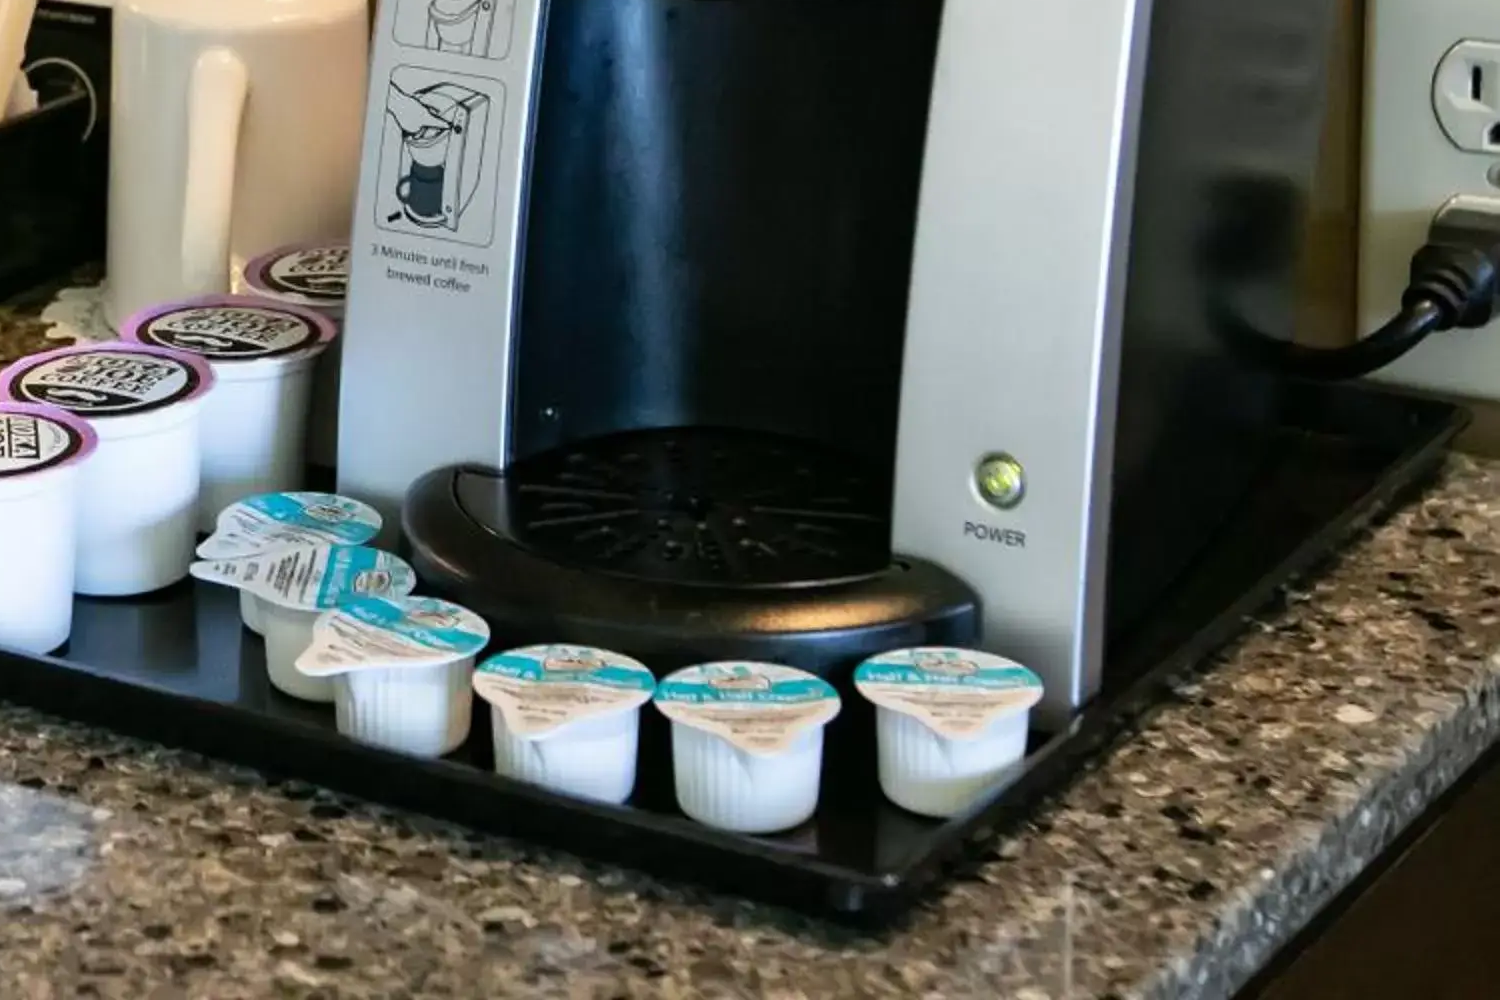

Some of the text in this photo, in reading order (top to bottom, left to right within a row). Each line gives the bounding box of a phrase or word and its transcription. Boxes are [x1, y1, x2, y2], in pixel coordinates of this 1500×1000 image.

[370, 243, 490, 276] 3 Minutes until fresh
[386, 265, 471, 292] brewed coffee
[964, 521, 1026, 547] POWER
